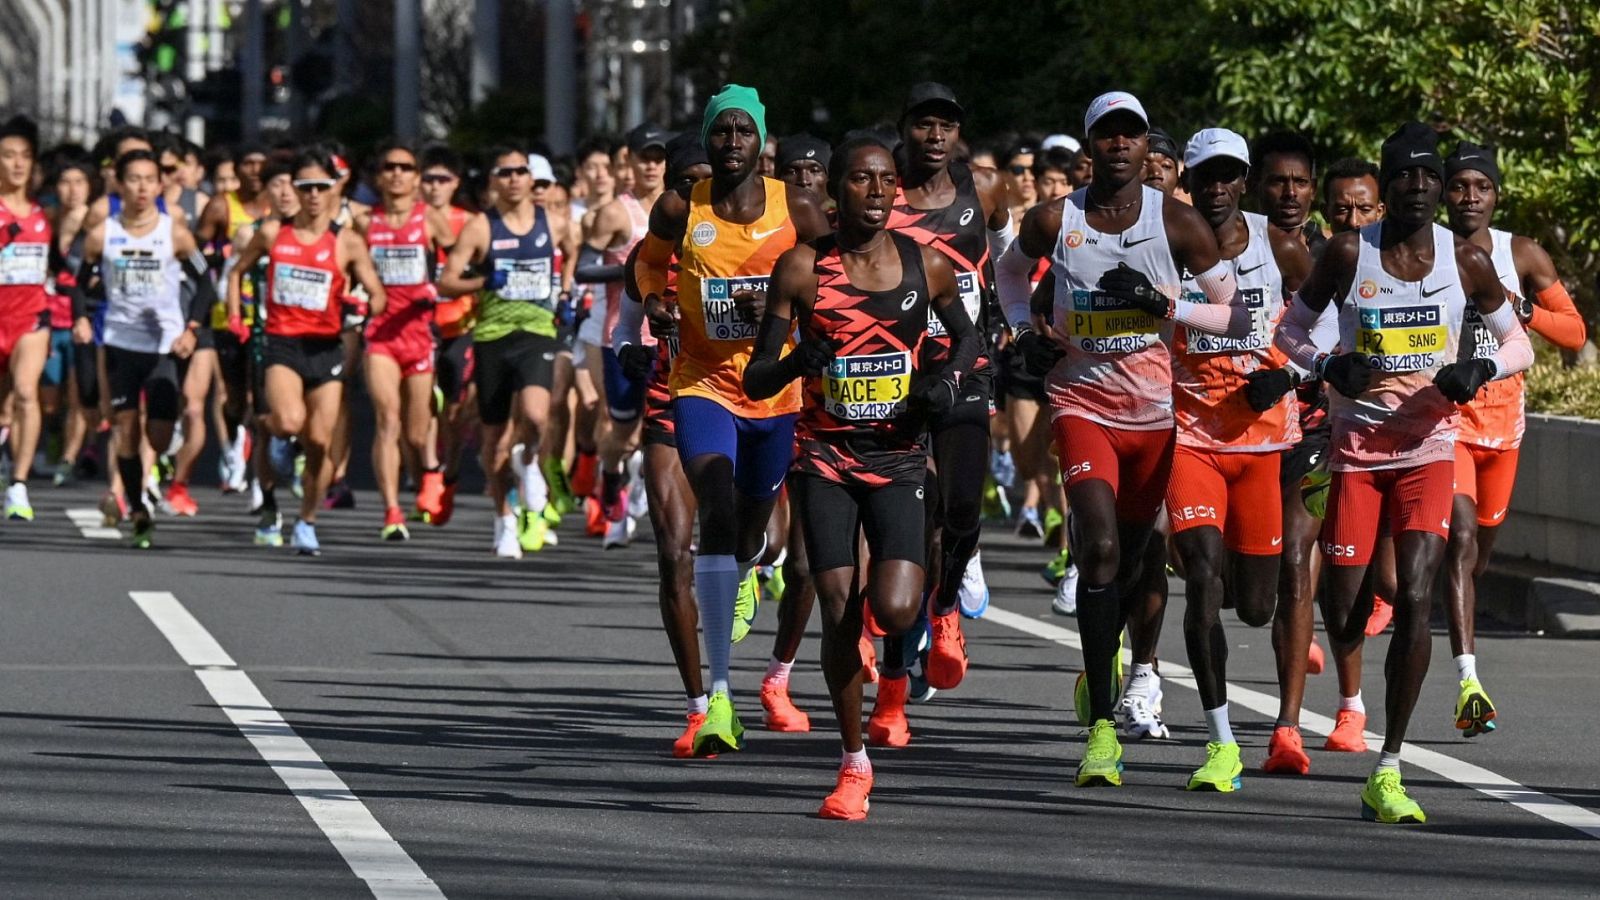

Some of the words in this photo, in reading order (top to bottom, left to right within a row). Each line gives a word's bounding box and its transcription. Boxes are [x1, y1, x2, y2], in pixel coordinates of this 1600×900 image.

[731, 281, 769, 294] 東京メト
[1380, 287, 1393, 295] NN
[705, 300, 739, 324] KIPL
[1383, 310, 1437, 324] 東京メトロ
[1105, 316, 1155, 330] KIPKEMBOI
[1408, 333, 1437, 348] SANG
[849, 360, 902, 374] 東京メトロ
[829, 379, 877, 403] PACE
[891, 377, 903, 400] 3
